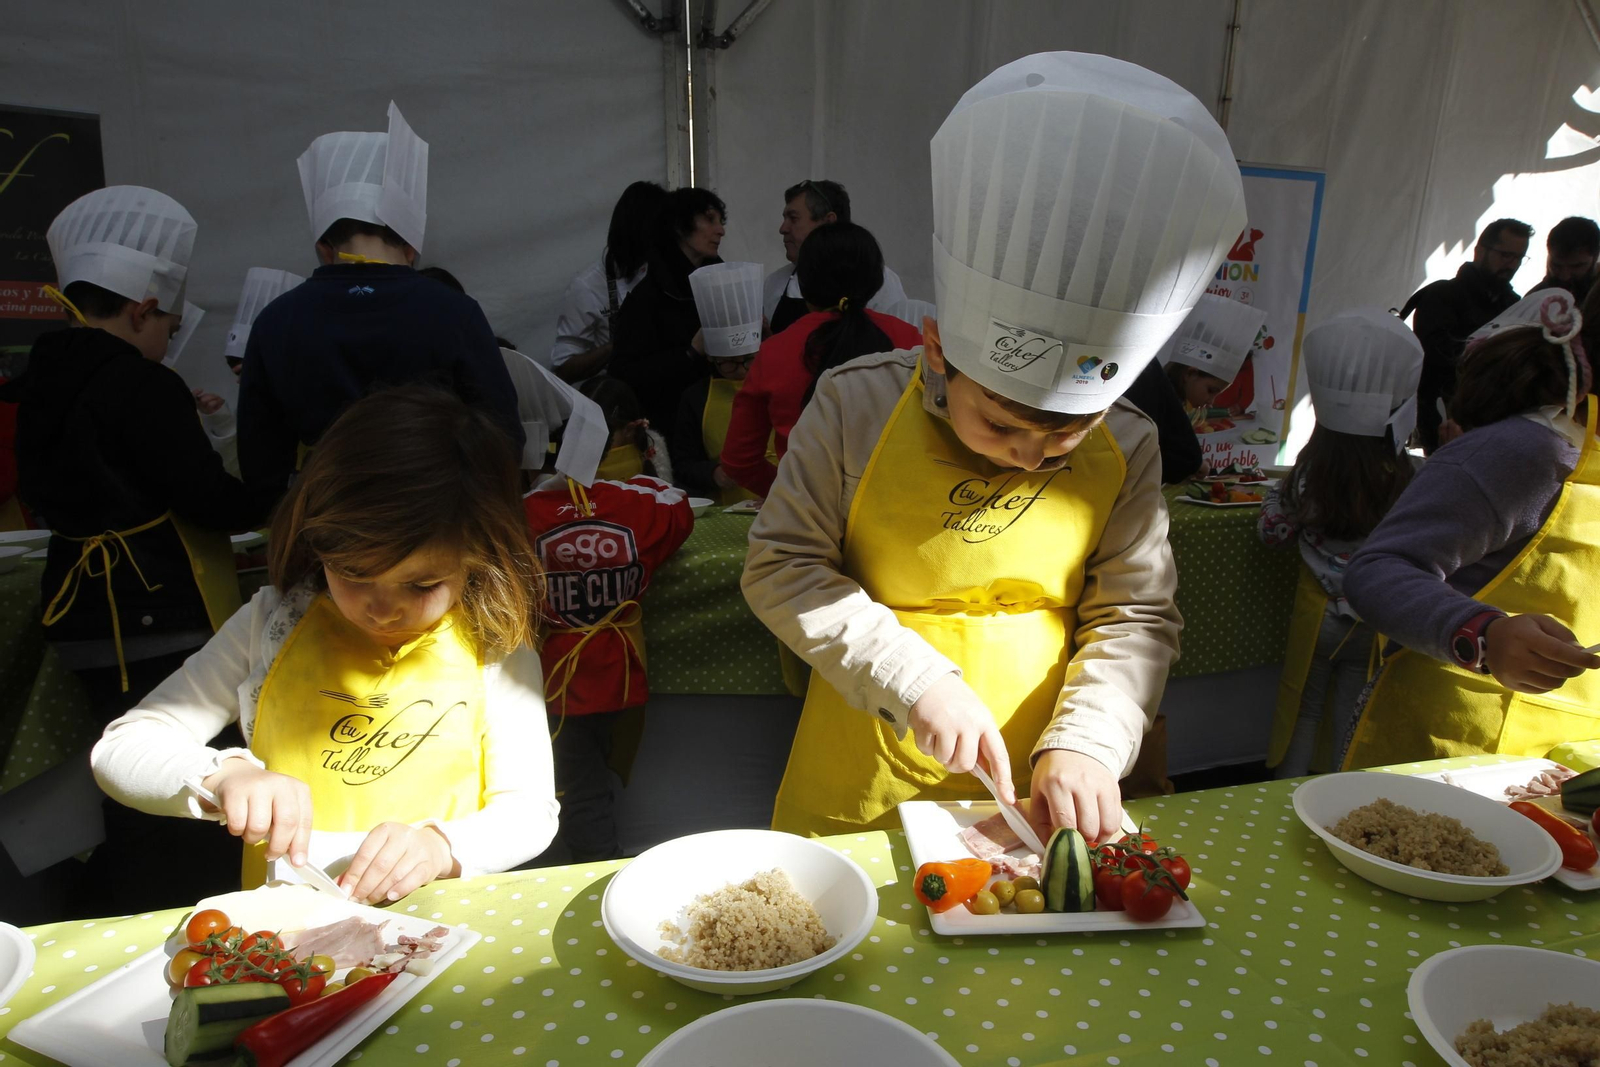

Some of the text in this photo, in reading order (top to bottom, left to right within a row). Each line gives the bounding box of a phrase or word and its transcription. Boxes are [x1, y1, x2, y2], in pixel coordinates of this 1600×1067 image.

[29, 304, 57, 315] para
[989, 350, 1019, 371] Talleres
[1207, 449, 1259, 469] ludable
[1216, 442, 1234, 452] un
[948, 466, 1072, 544] tu Chef
[940, 508, 1002, 535] Talleres
[555, 532, 619, 569] ego
[547, 565, 640, 613] HE CLUB
[329, 699, 467, 786] tu Chef
[320, 746, 388, 776] Talleres
